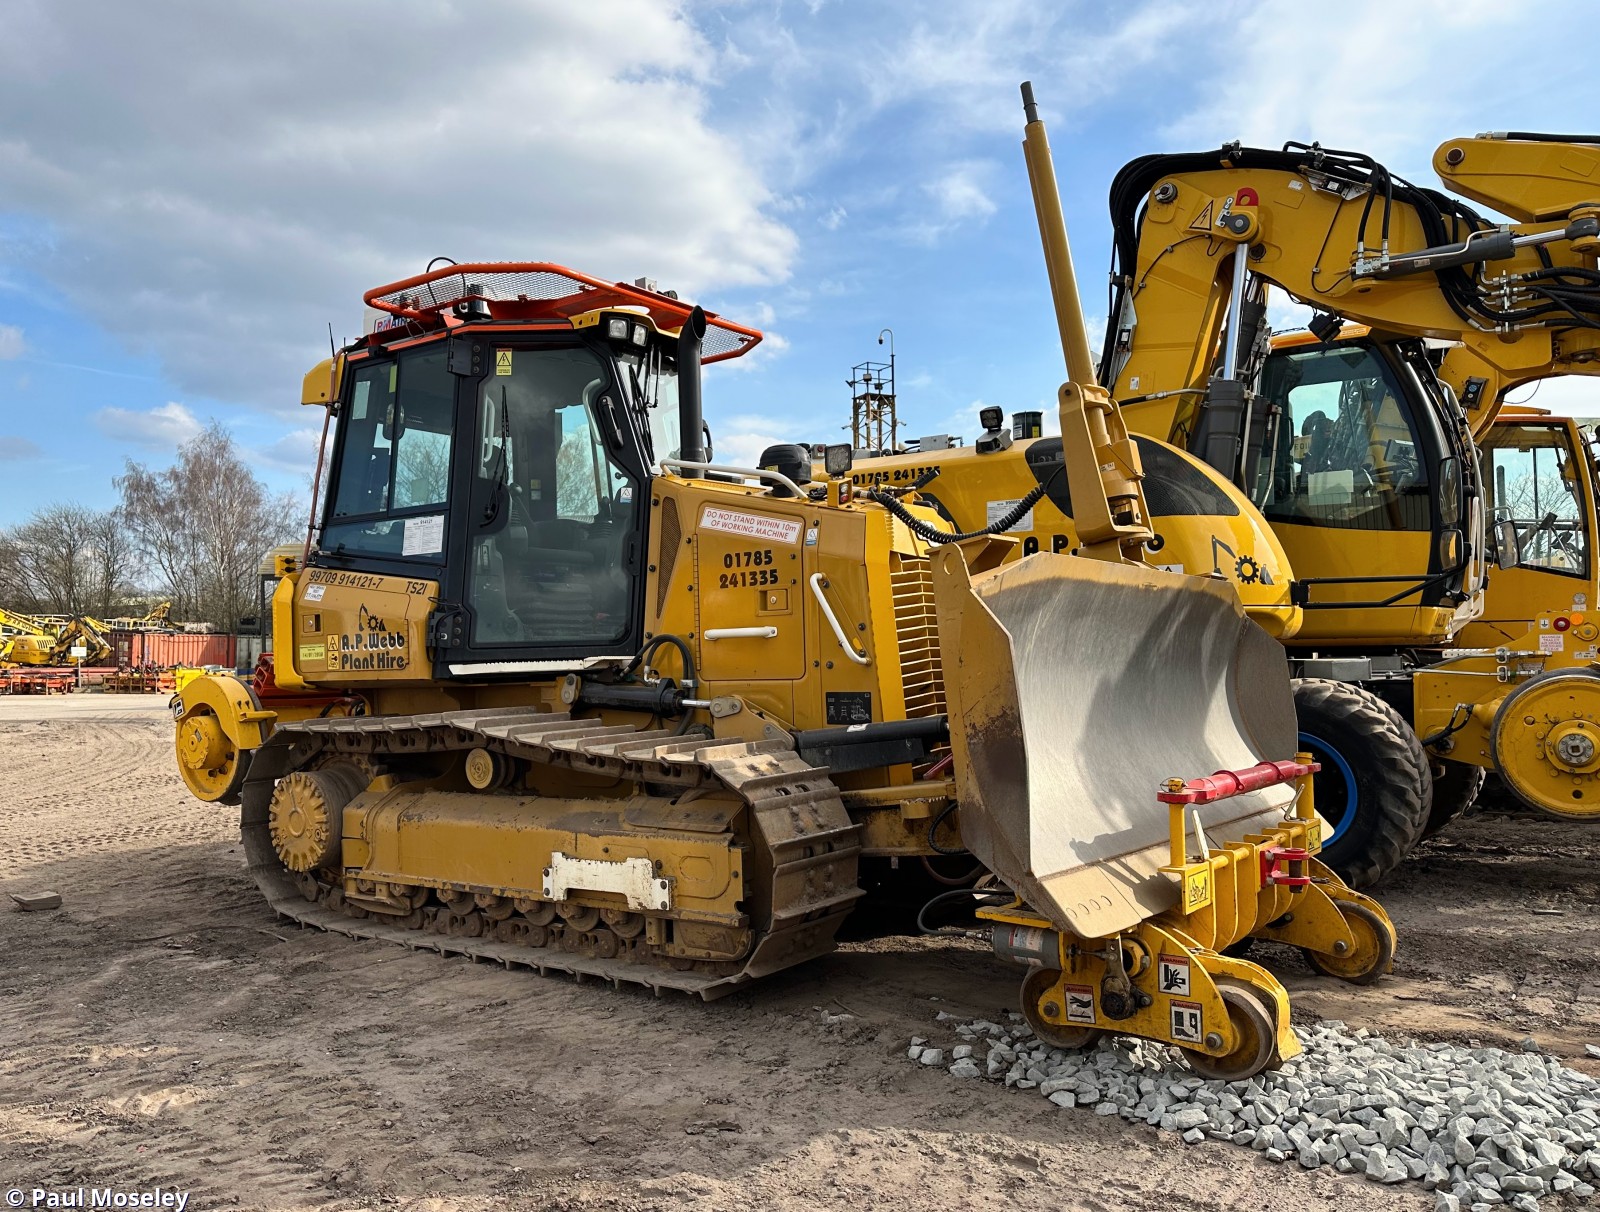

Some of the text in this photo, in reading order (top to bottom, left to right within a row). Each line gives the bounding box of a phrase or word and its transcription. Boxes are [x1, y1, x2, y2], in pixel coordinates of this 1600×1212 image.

[706, 510, 797, 533] DO NOT STAND WITHIN 10m
[710, 519, 789, 540] OF WORKING MACHINE
[723, 549, 773, 569] 01785
[309, 570, 337, 584] 99709
[338, 573, 384, 589] 914121-7
[719, 569, 779, 589] 241335
[341, 651, 405, 670] Plant Hire
